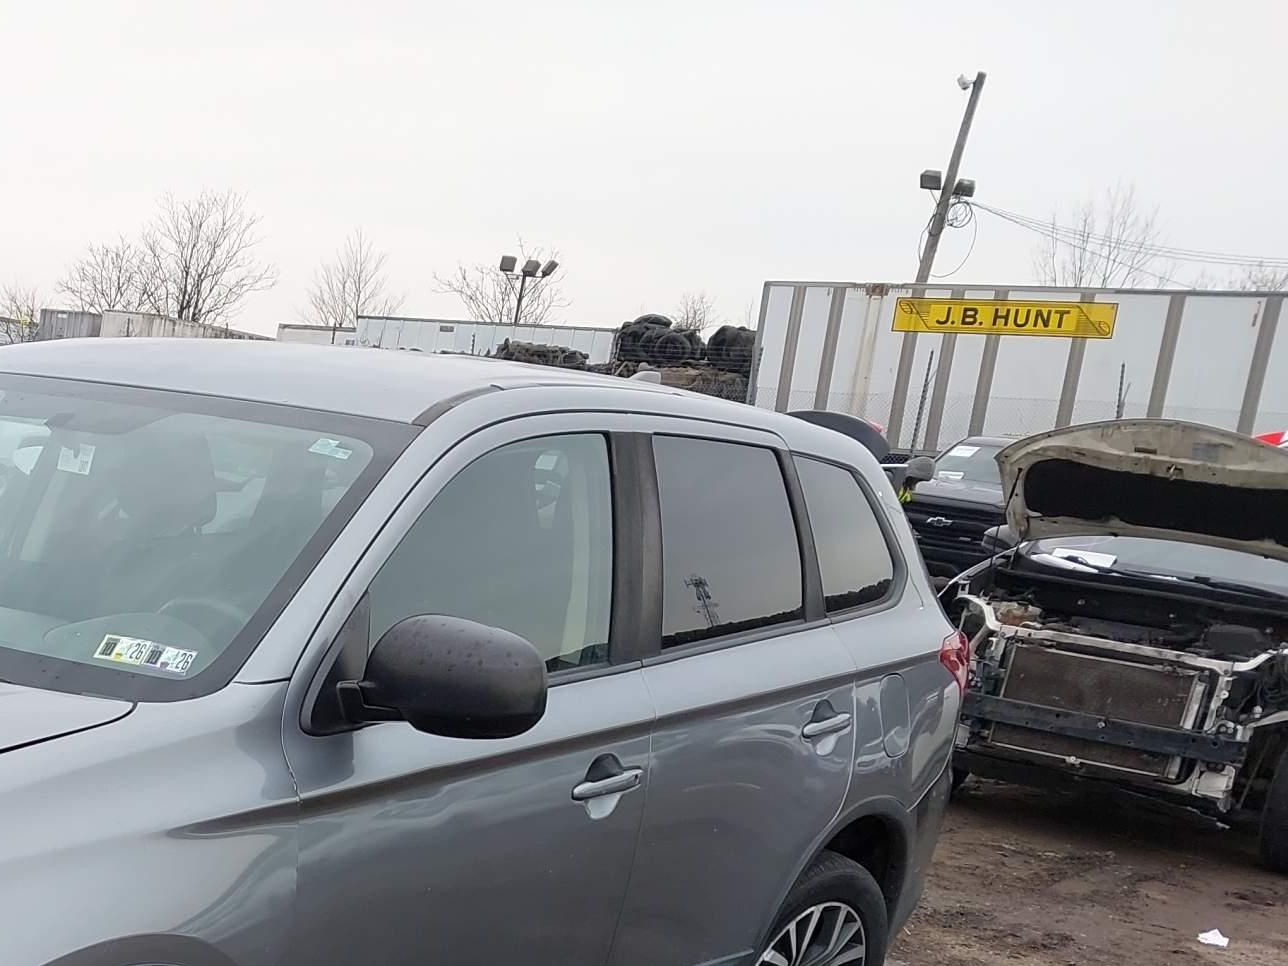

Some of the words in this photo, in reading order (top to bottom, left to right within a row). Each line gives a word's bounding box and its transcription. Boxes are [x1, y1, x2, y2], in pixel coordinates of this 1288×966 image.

[992, 308, 1071, 329] HUNT
[129, 642, 147, 660] 26
[176, 652, 193, 670] 26
